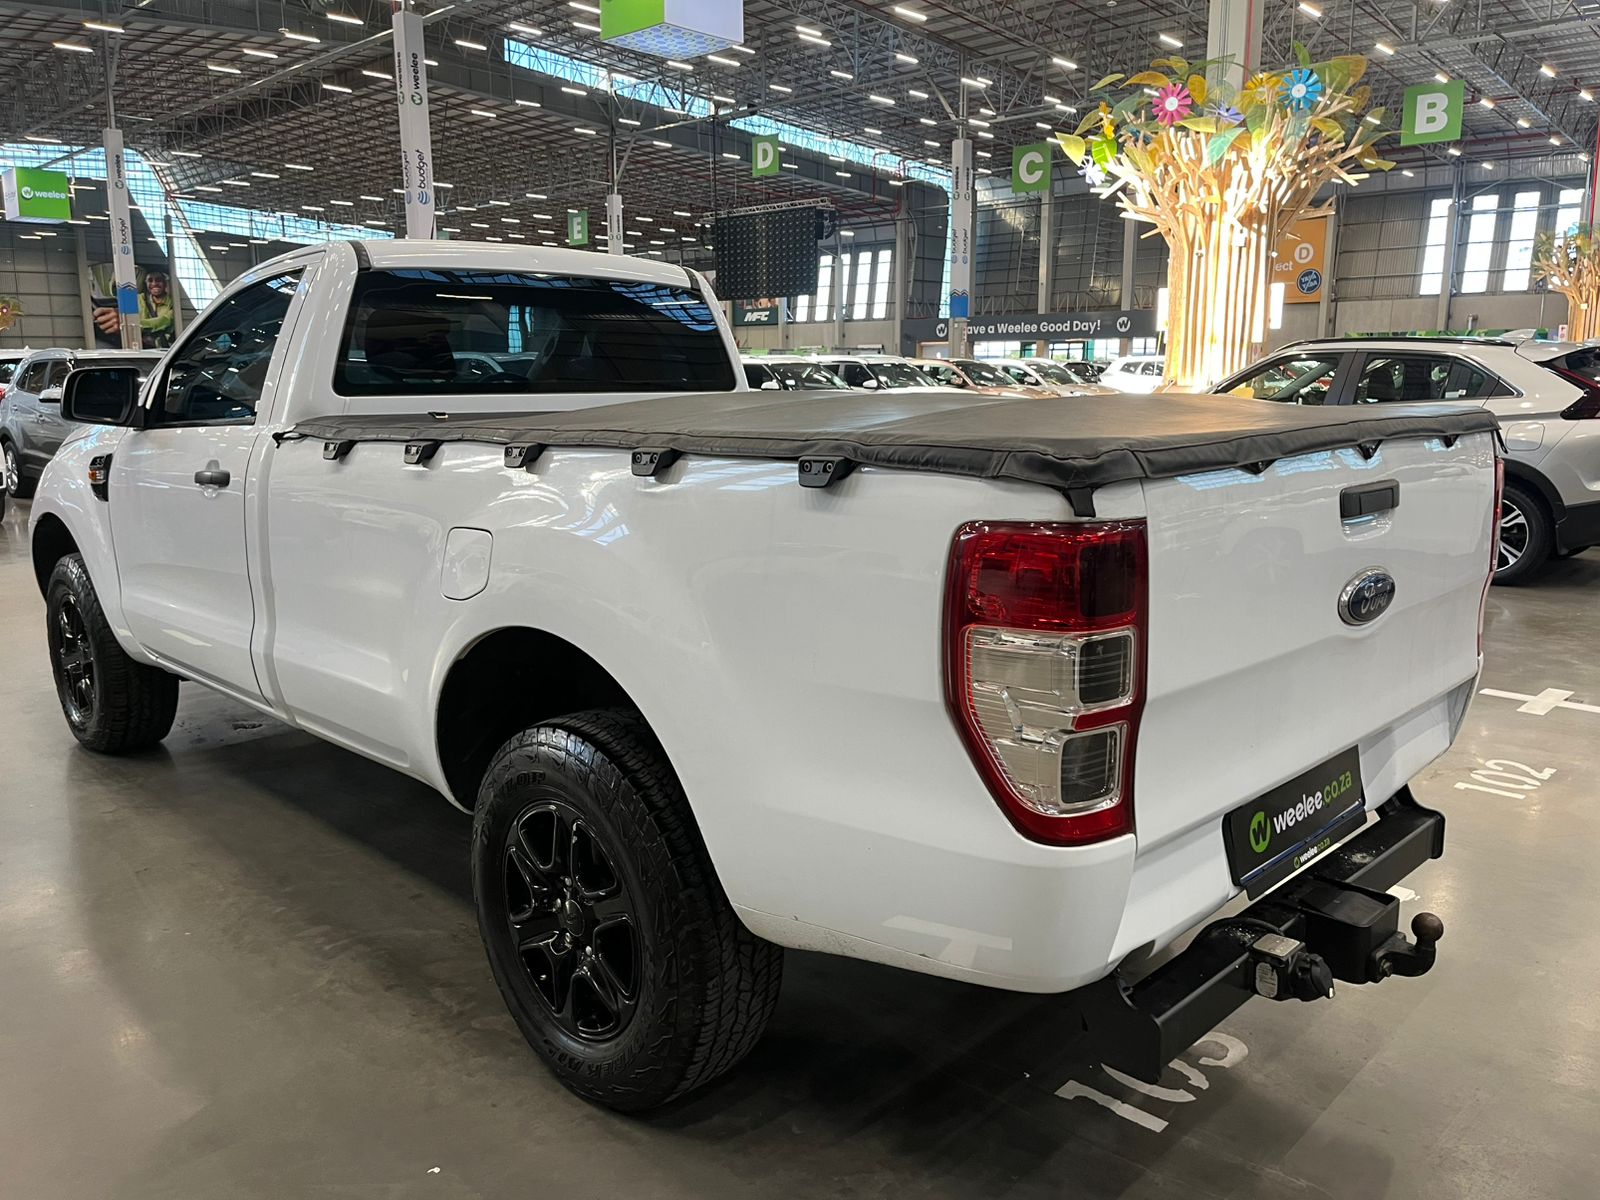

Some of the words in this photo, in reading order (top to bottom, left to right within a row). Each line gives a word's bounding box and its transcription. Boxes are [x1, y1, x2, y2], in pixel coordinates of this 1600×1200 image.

[410, 52, 420, 90] weelee
[1415, 92, 1449, 135] B
[415, 149, 428, 189] budget
[757, 141, 774, 169] D
[1018, 151, 1044, 184] C
[34, 190, 67, 199] weelee
[573, 216, 583, 240] E
[1275, 260, 1294, 271] ect
[744, 311, 770, 322] MFC
[967, 325, 986, 335] ave
[987, 325, 995, 334] a
[997, 321, 1037, 334] Weelee
[1040, 319, 1071, 332] Good
[1073, 319, 1101, 334] Day!
[1454, 759, 1557, 799] 102
[1273, 771, 1352, 834] weelee.co.za
